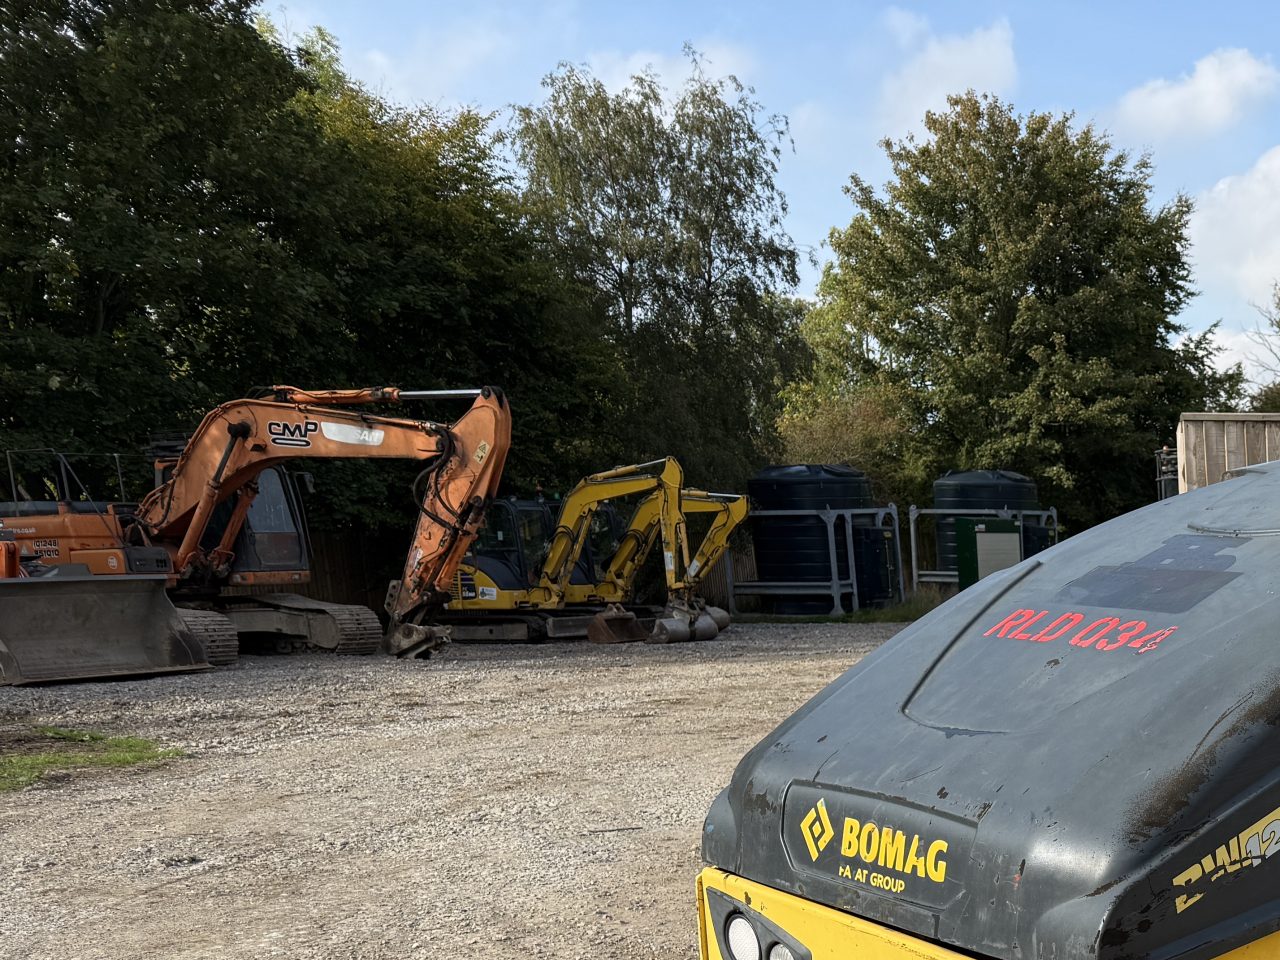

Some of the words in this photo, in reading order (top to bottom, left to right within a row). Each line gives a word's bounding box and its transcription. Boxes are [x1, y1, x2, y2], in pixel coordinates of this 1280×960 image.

[267, 420, 319, 438] CMP
[983, 609, 1085, 642] RLD
[1068, 616, 1179, 656] 034
[840, 816, 949, 883] BOMAG
[869, 872, 905, 894] GROUP
